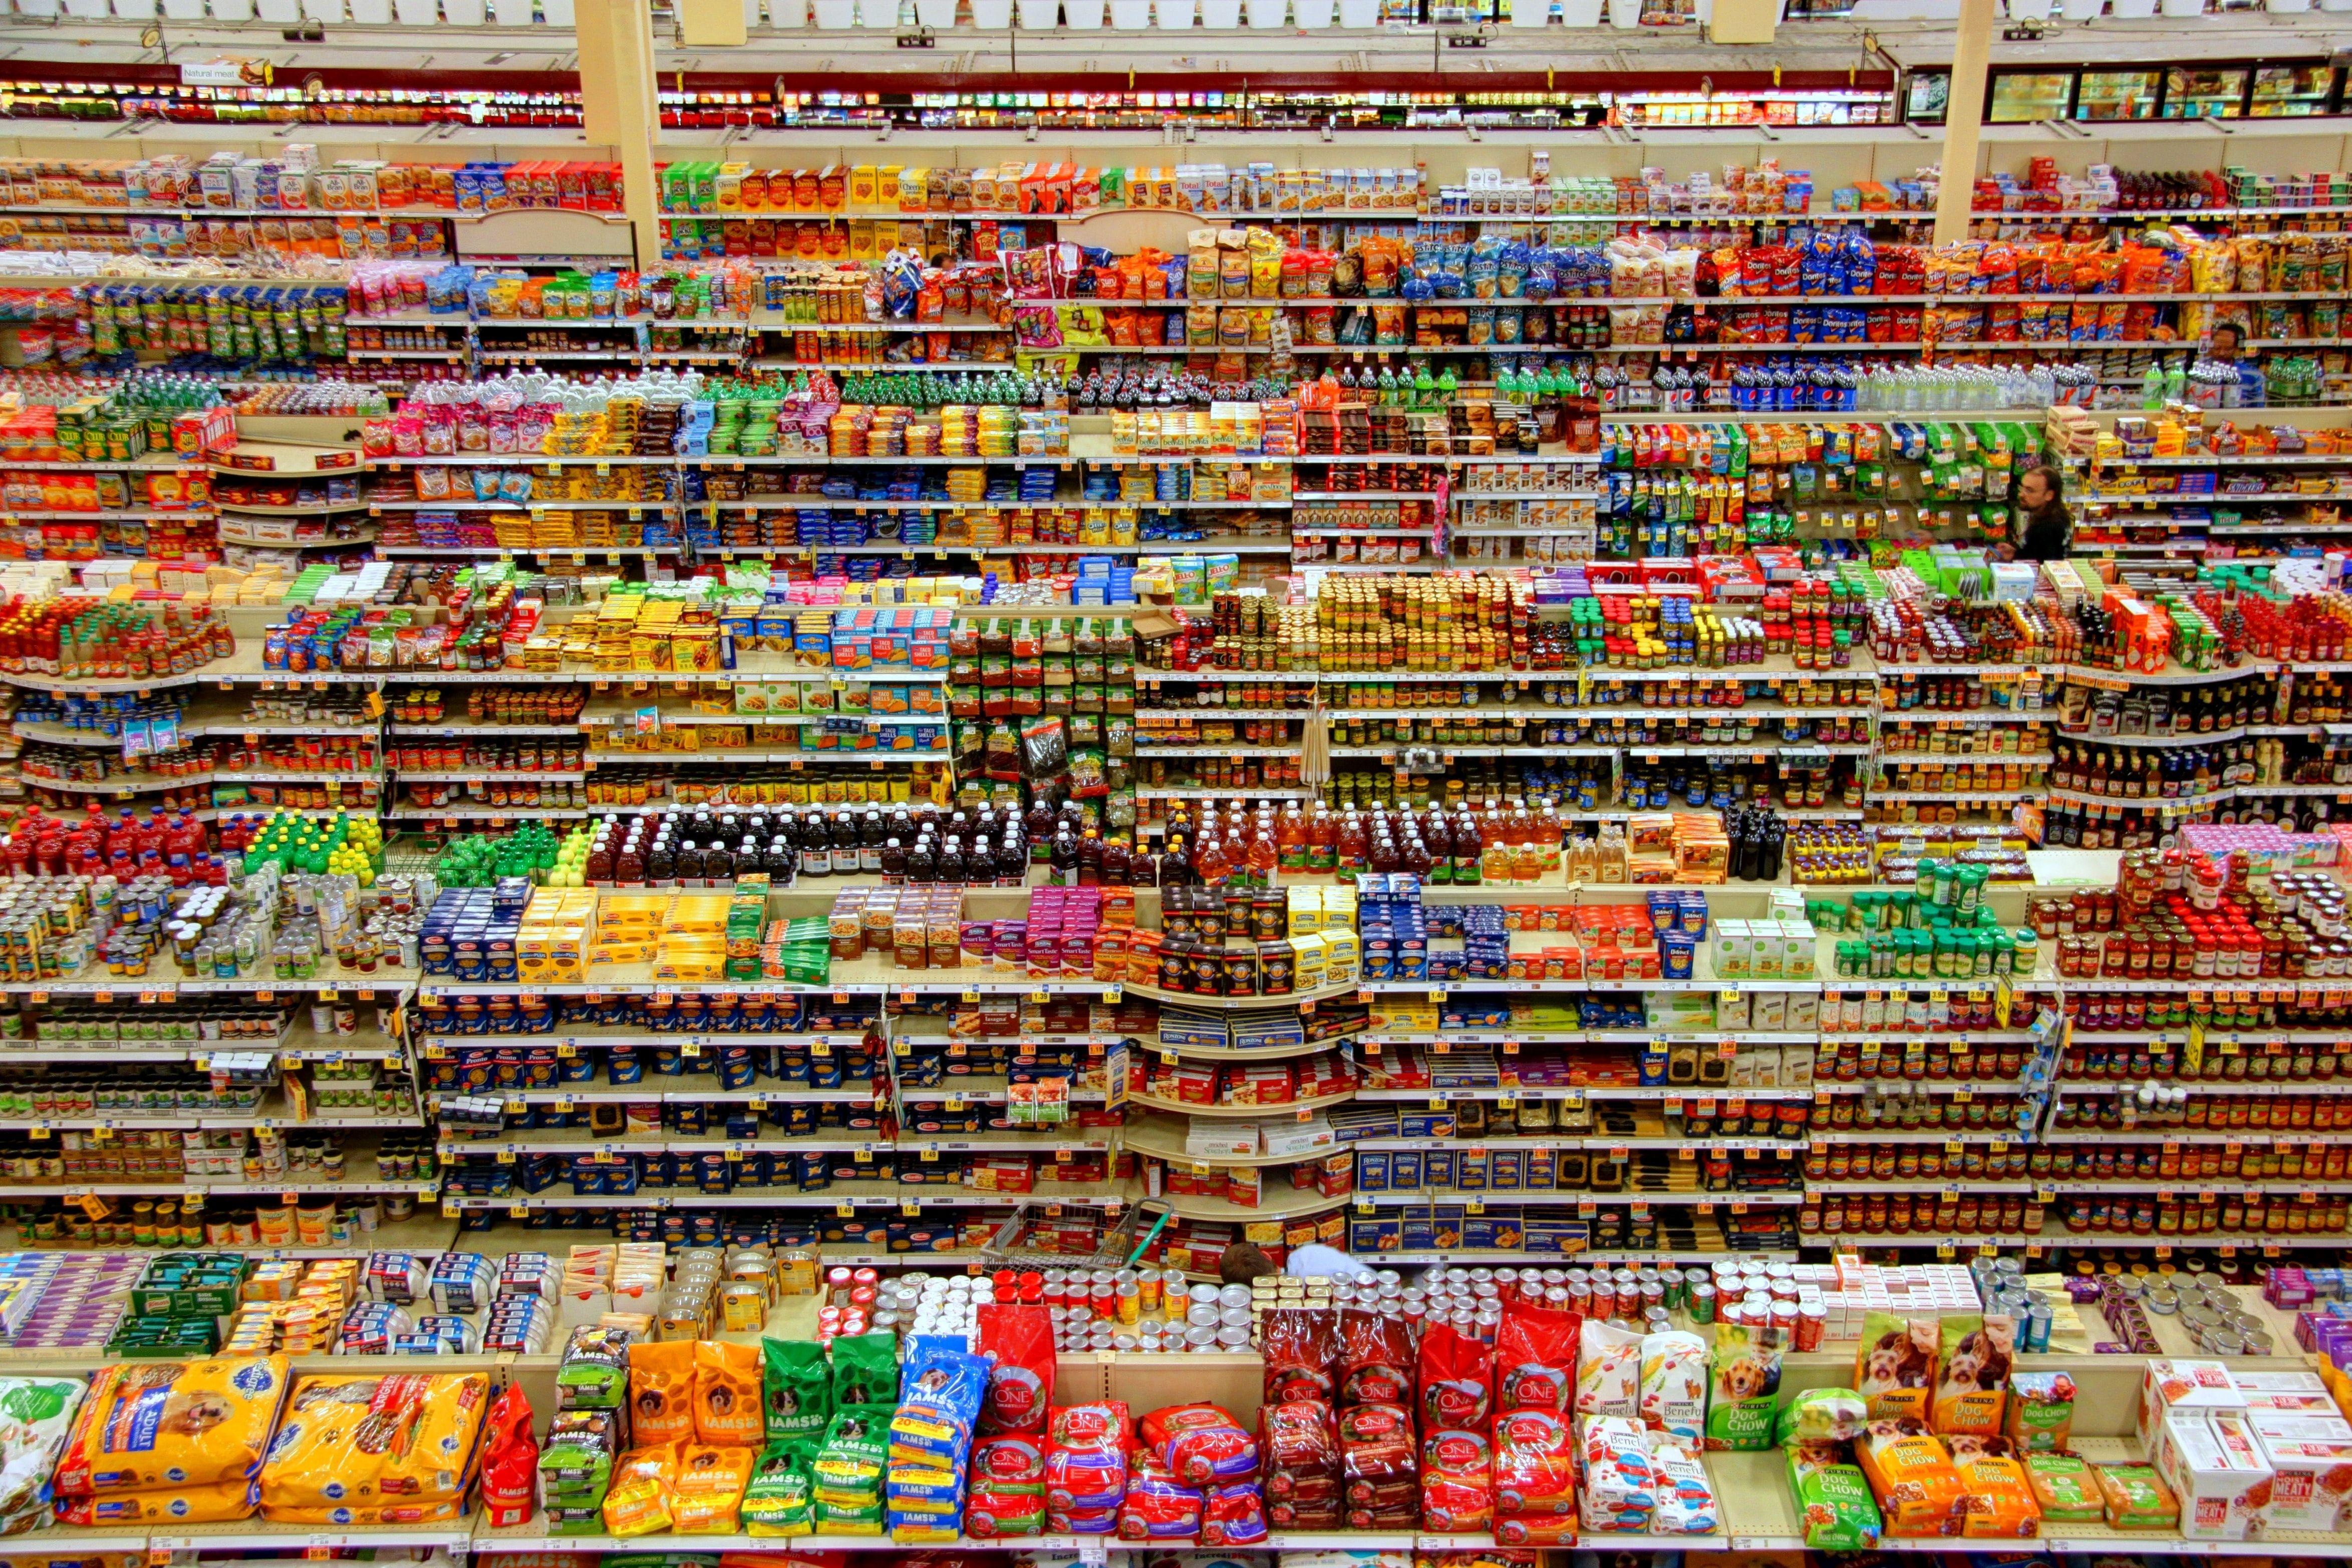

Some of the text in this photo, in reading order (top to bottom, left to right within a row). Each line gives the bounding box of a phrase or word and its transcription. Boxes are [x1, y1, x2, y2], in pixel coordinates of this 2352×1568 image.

[1210, 564, 1230, 575] JELL-O
[1174, 572, 1195, 580] JELL-O
[572, 1352, 601, 1360] IAMS
[906, 1392, 945, 1403] IAMS
[996, 1390, 1030, 1403] ONE
[1283, 1391, 1316, 1401] ONE
[1730, 1409, 1757, 1420] DOG
[1955, 1404, 1981, 1415] DOG
[704, 1416, 742, 1429] IAMS
[769, 1416, 810, 1427] IAMS
[1068, 1419, 1102, 1430] ONE
[1355, 1417, 1390, 1427] ONE
[1728, 1419, 1768, 1430] CHOW
[1954, 1415, 1991, 1426] CHOW
[139, 1410, 154, 1449] ADULT
[900, 1434, 924, 1444] IAMS
[1439, 1444, 1475, 1455] ONE
[1893, 1447, 1922, 1458] DOG
[1899, 1454, 1937, 1465] CHOW
[2052, 1459, 2079, 1467] CHOW
[682, 1472, 723, 1481] IAMS
[1820, 1474, 1848, 1485] DOG
[498, 1487, 522, 1495] IAMS
[1821, 1484, 1863, 1495] CHOW
[2274, 1482, 2312, 1497] MEATY
[2195, 1508, 2227, 1519] MEATY
[152, 1553, 171, 1561] 20.99
